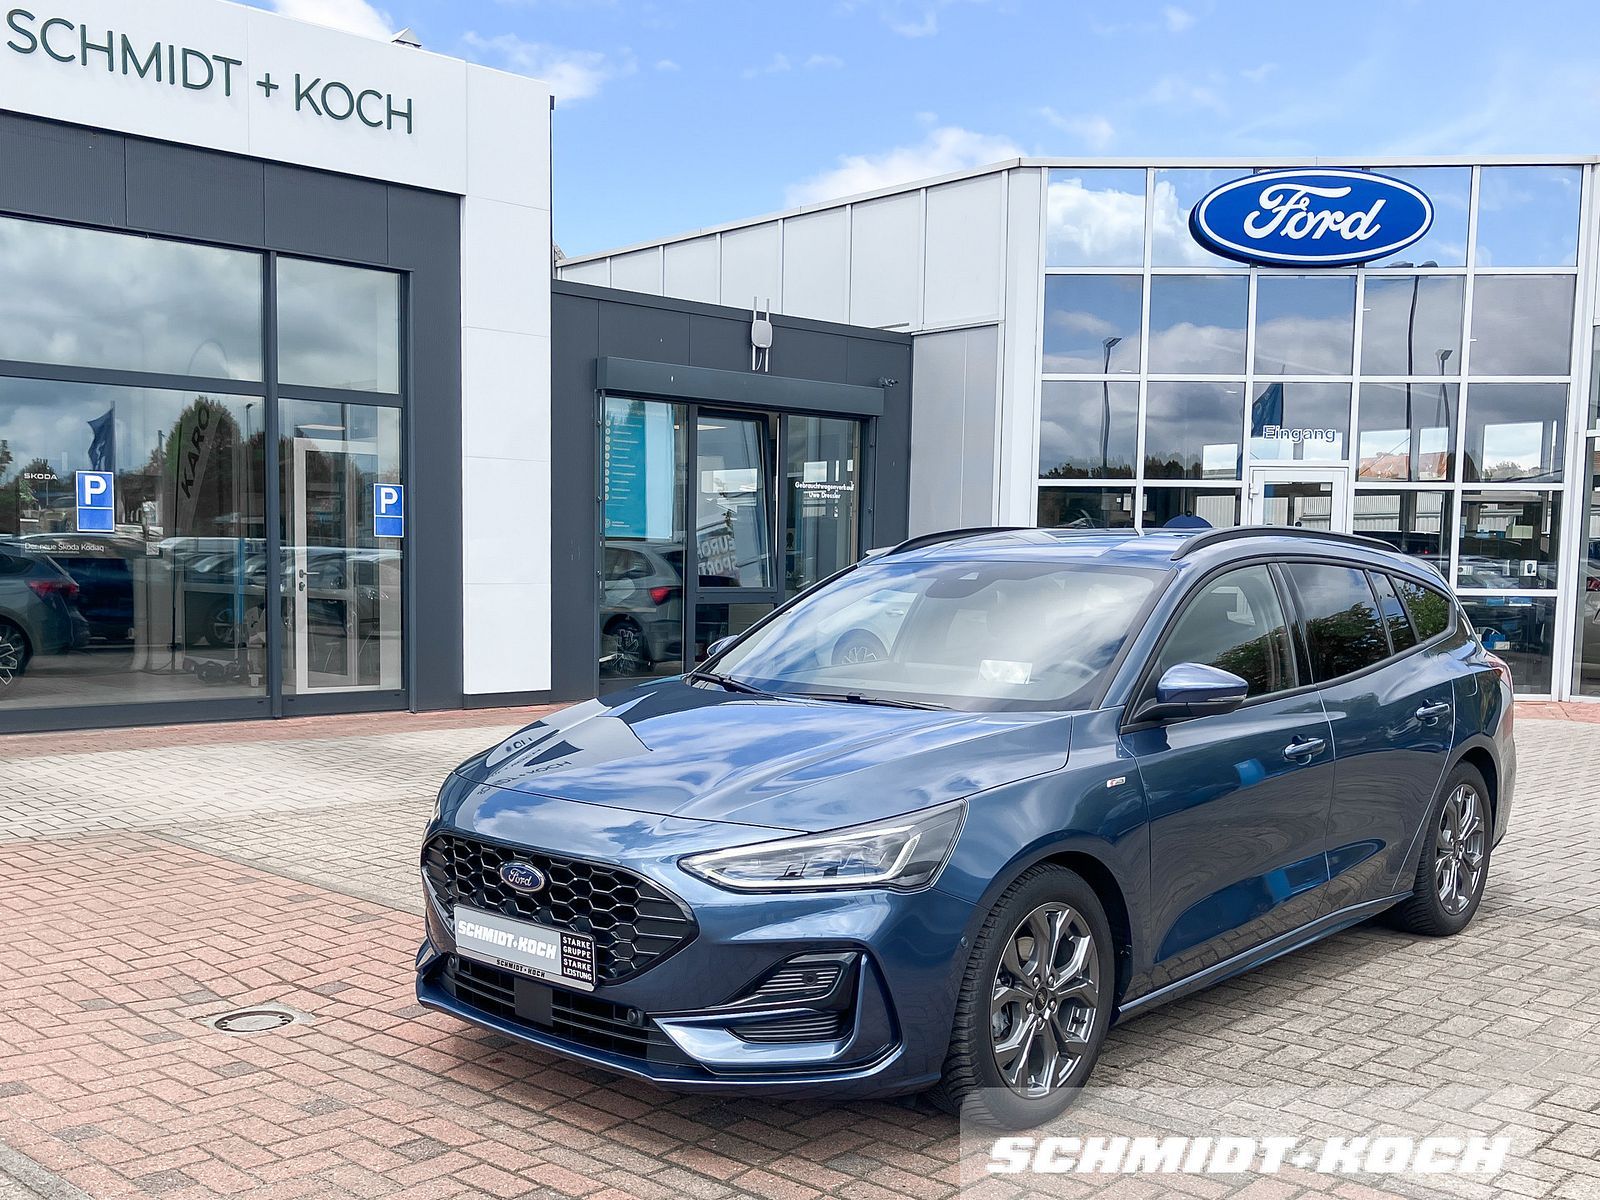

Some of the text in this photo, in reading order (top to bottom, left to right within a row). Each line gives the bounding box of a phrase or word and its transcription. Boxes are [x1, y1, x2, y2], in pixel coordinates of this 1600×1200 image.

[6, 9, 413, 134] SCHMIDT + KOCH
[1243, 184, 1387, 241] Ford
[1263, 425, 1337, 443] Eingang
[84, 475, 107, 505] P
[380, 487, 398, 514] P
[508, 868, 533, 887] Ford
[562, 936, 592, 950] STARKE
[562, 945, 592, 959] GRUPPE
[563, 958, 592, 972] STARKE
[563, 966, 593, 981] LEISTUNG
